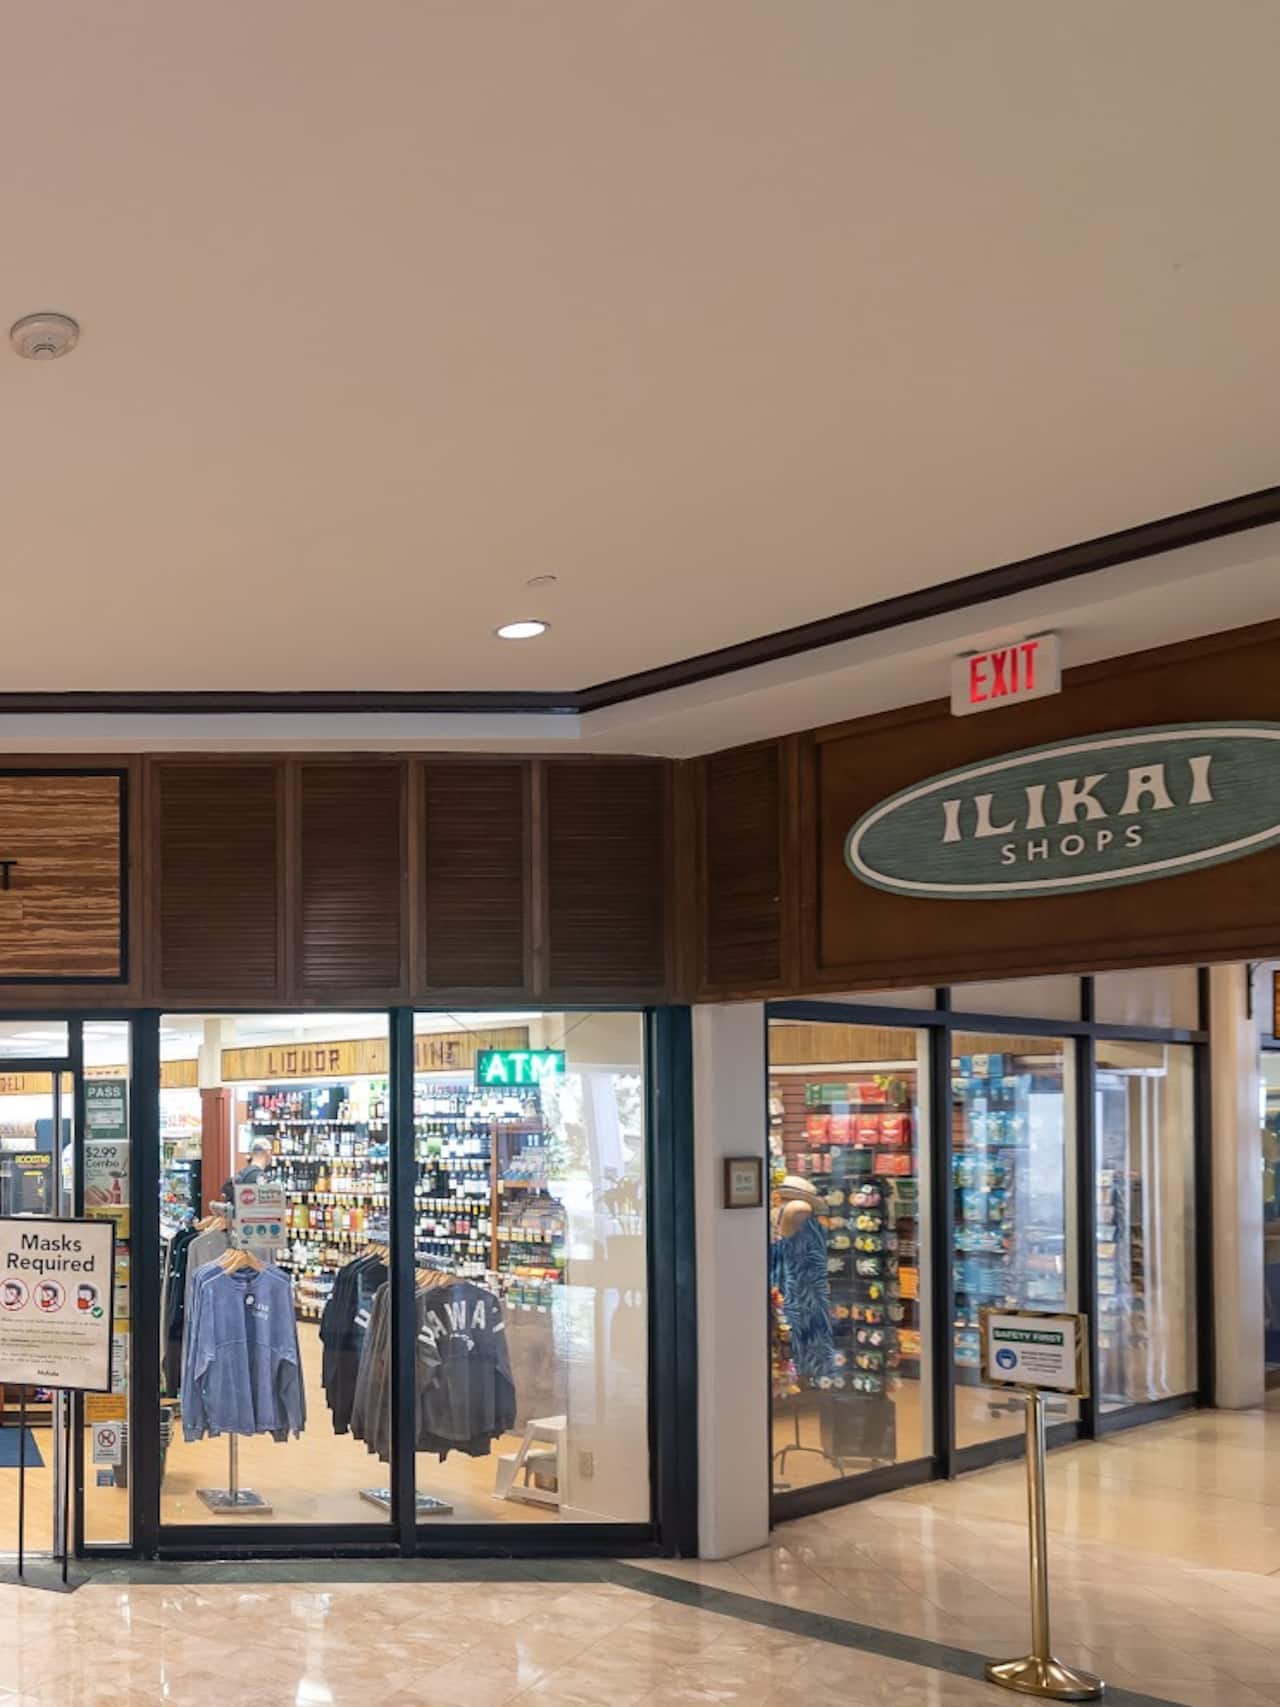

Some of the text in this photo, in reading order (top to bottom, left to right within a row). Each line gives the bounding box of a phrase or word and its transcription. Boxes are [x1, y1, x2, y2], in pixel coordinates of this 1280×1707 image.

[969, 642, 1039, 704] EXIT
[941, 755, 1214, 843] ILIKAI
[1000, 825, 1144, 866] SHOPS
[269, 1040, 461, 1074] LIQUOR INE
[484, 1052, 559, 1083] ATM
[87, 1086, 122, 1098] PASS
[86, 1146, 118, 1159] $2.99
[86, 1159, 120, 1169] Combo
[21, 1233, 83, 1252] Masks
[6, 1252, 96, 1275] Required
[994, 1329, 1032, 1341] SAFETY
